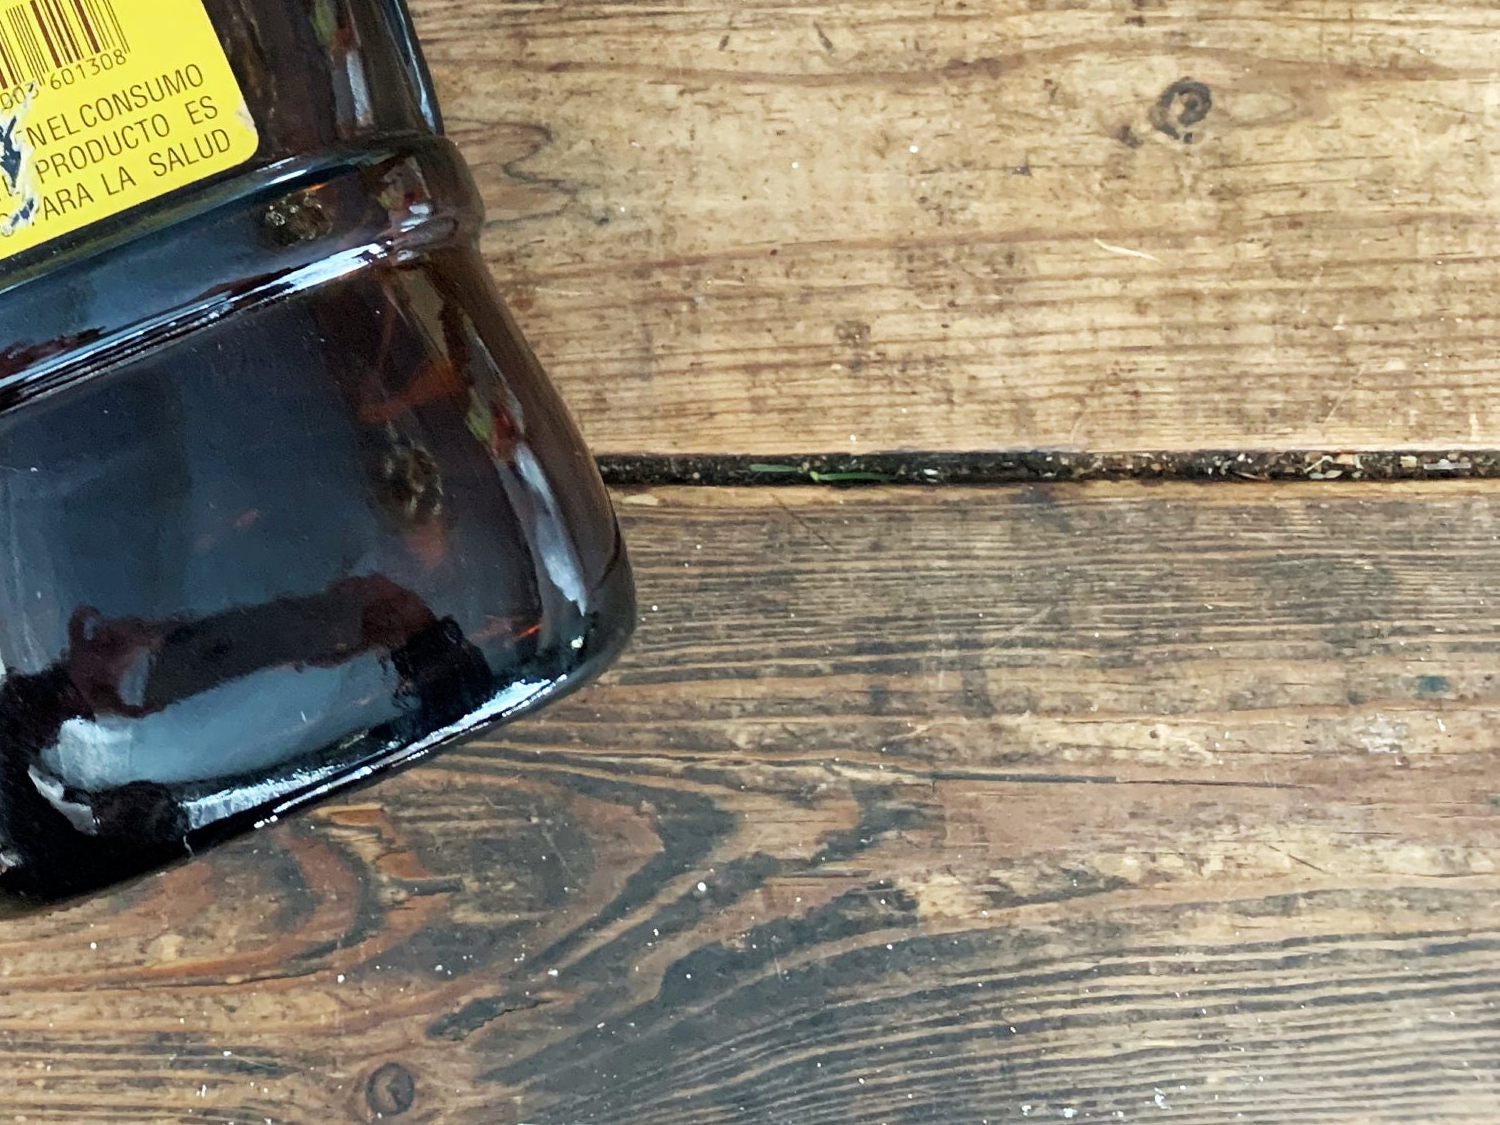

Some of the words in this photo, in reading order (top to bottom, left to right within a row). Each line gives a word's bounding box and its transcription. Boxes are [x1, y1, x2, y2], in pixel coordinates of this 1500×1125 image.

[47, 113, 81, 141] EL
[79, 63, 204, 128] CONSUMO
[50, 48, 127, 90] 601308
[31, 183, 95, 226] ARA
[101, 166, 137, 196] LA
[149, 128, 231, 177] SALUD
[35, 113, 171, 184] PRODUCTO
[184, 95, 218, 126] ES
